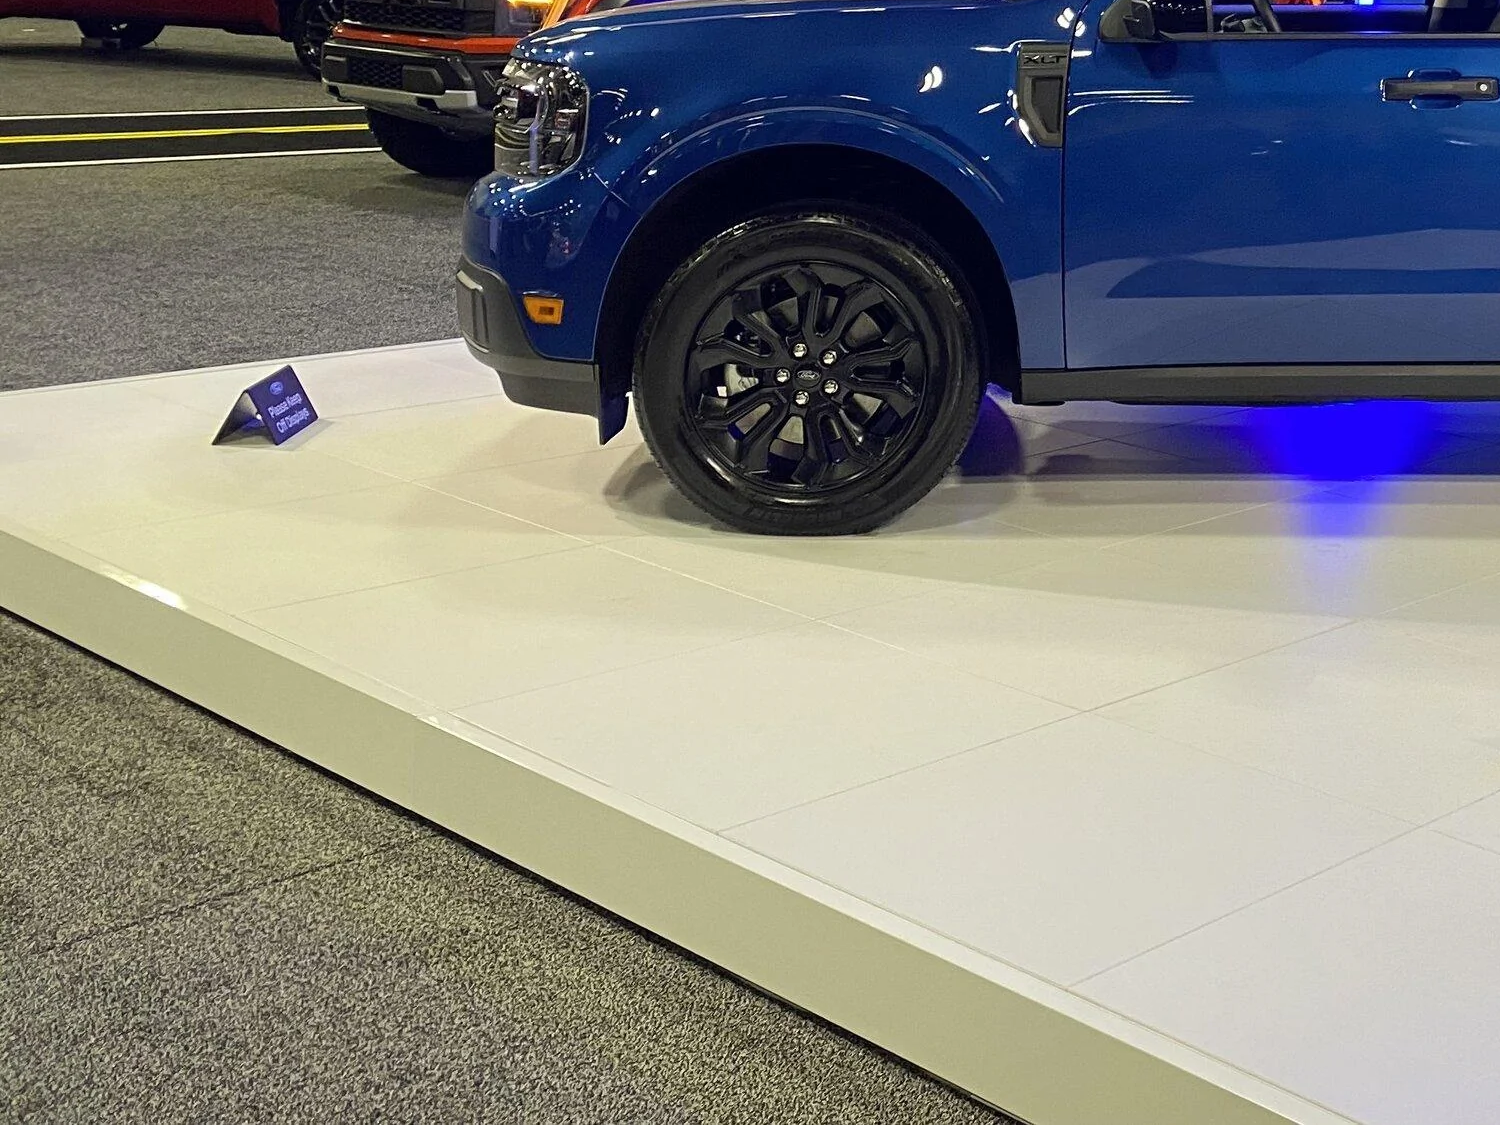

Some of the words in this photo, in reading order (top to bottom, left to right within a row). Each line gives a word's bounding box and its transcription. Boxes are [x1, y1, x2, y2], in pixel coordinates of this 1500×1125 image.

[1023, 55, 1069, 65] XLT
[268, 400, 289, 418] Please
[286, 392, 303, 408] Keep
[276, 418, 286, 434] Off
[285, 407, 310, 428] Displays
